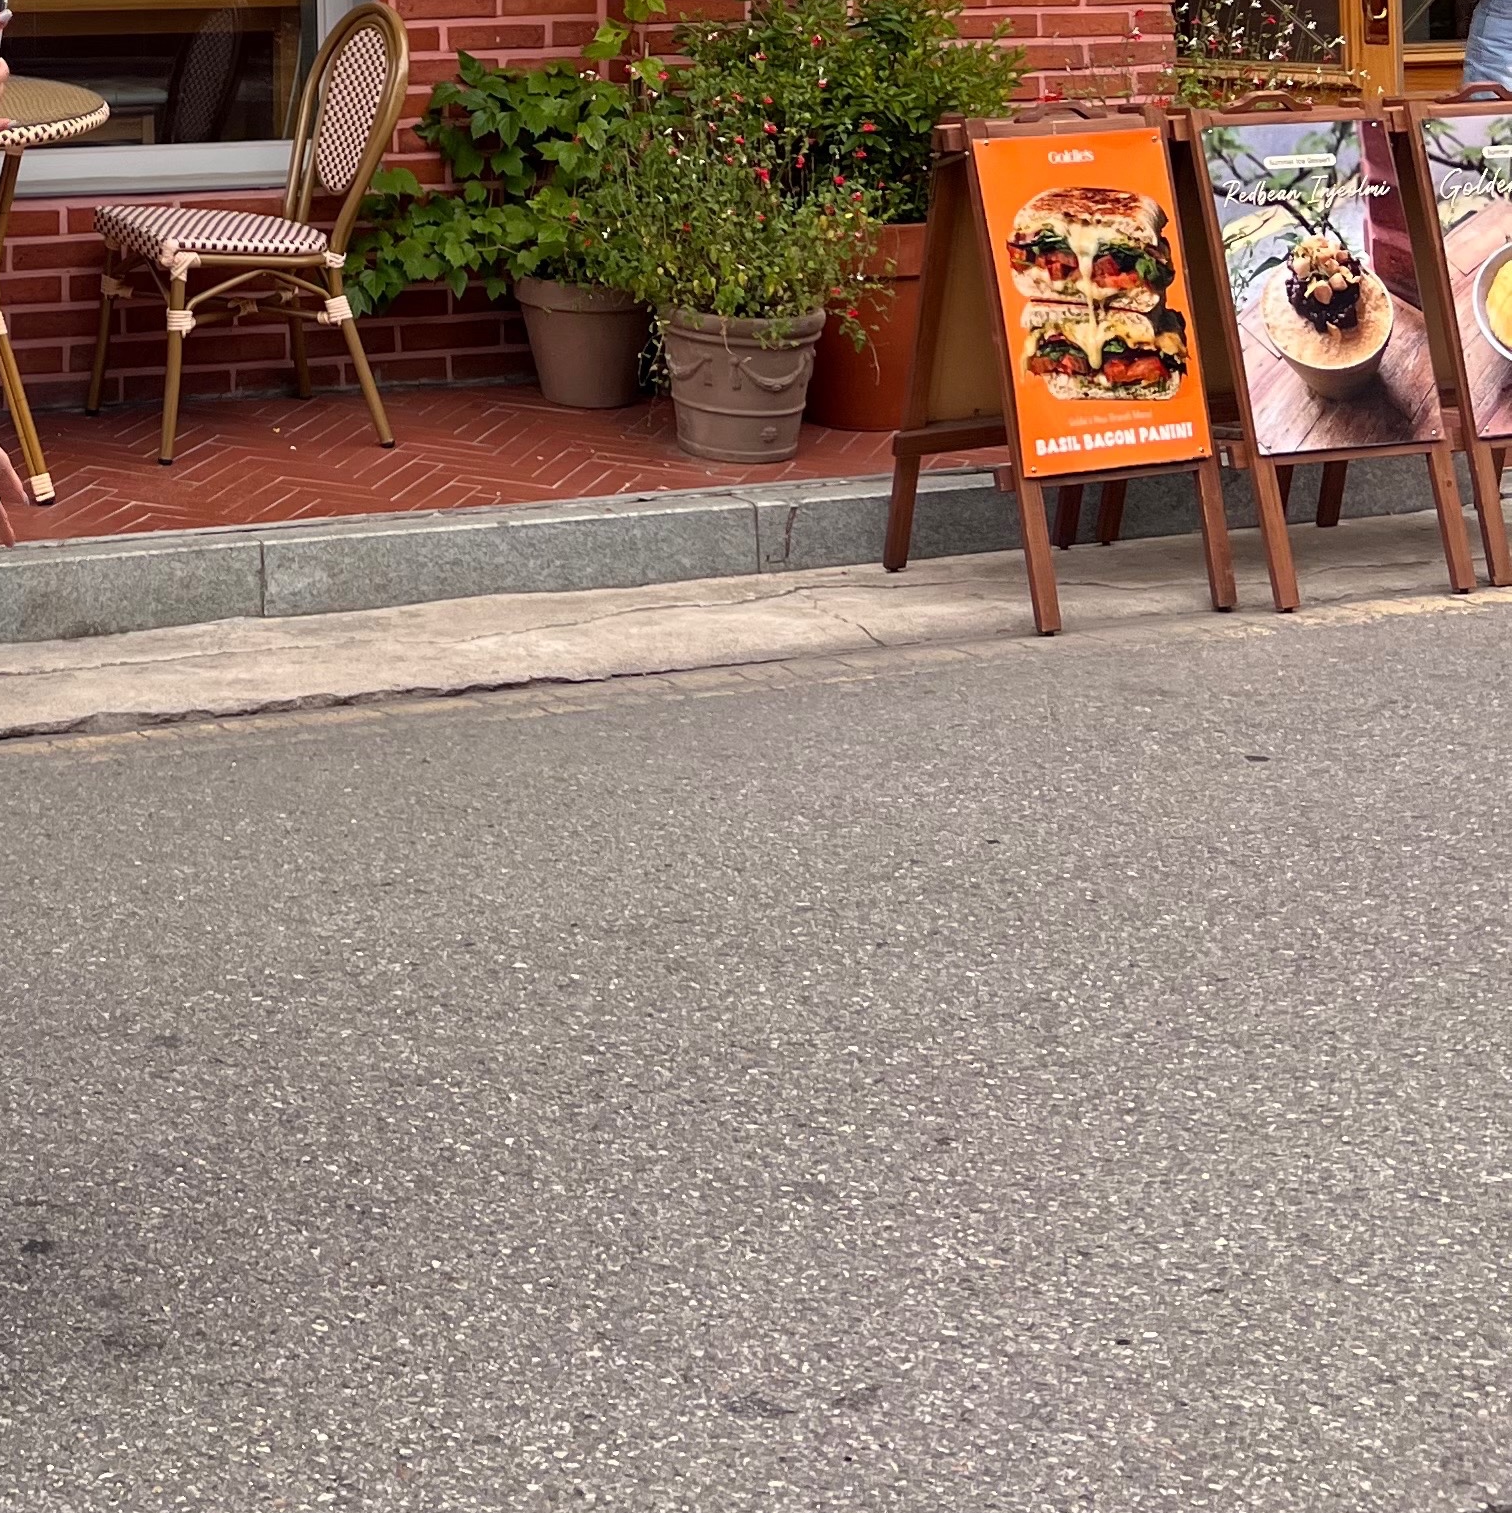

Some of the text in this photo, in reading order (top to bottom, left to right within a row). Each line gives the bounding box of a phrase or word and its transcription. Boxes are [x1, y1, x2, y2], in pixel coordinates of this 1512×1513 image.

[1222, 175, 1391, 209] Redbean Injeolmi
[1035, 421, 1194, 456] BASIL BACON PANINI
